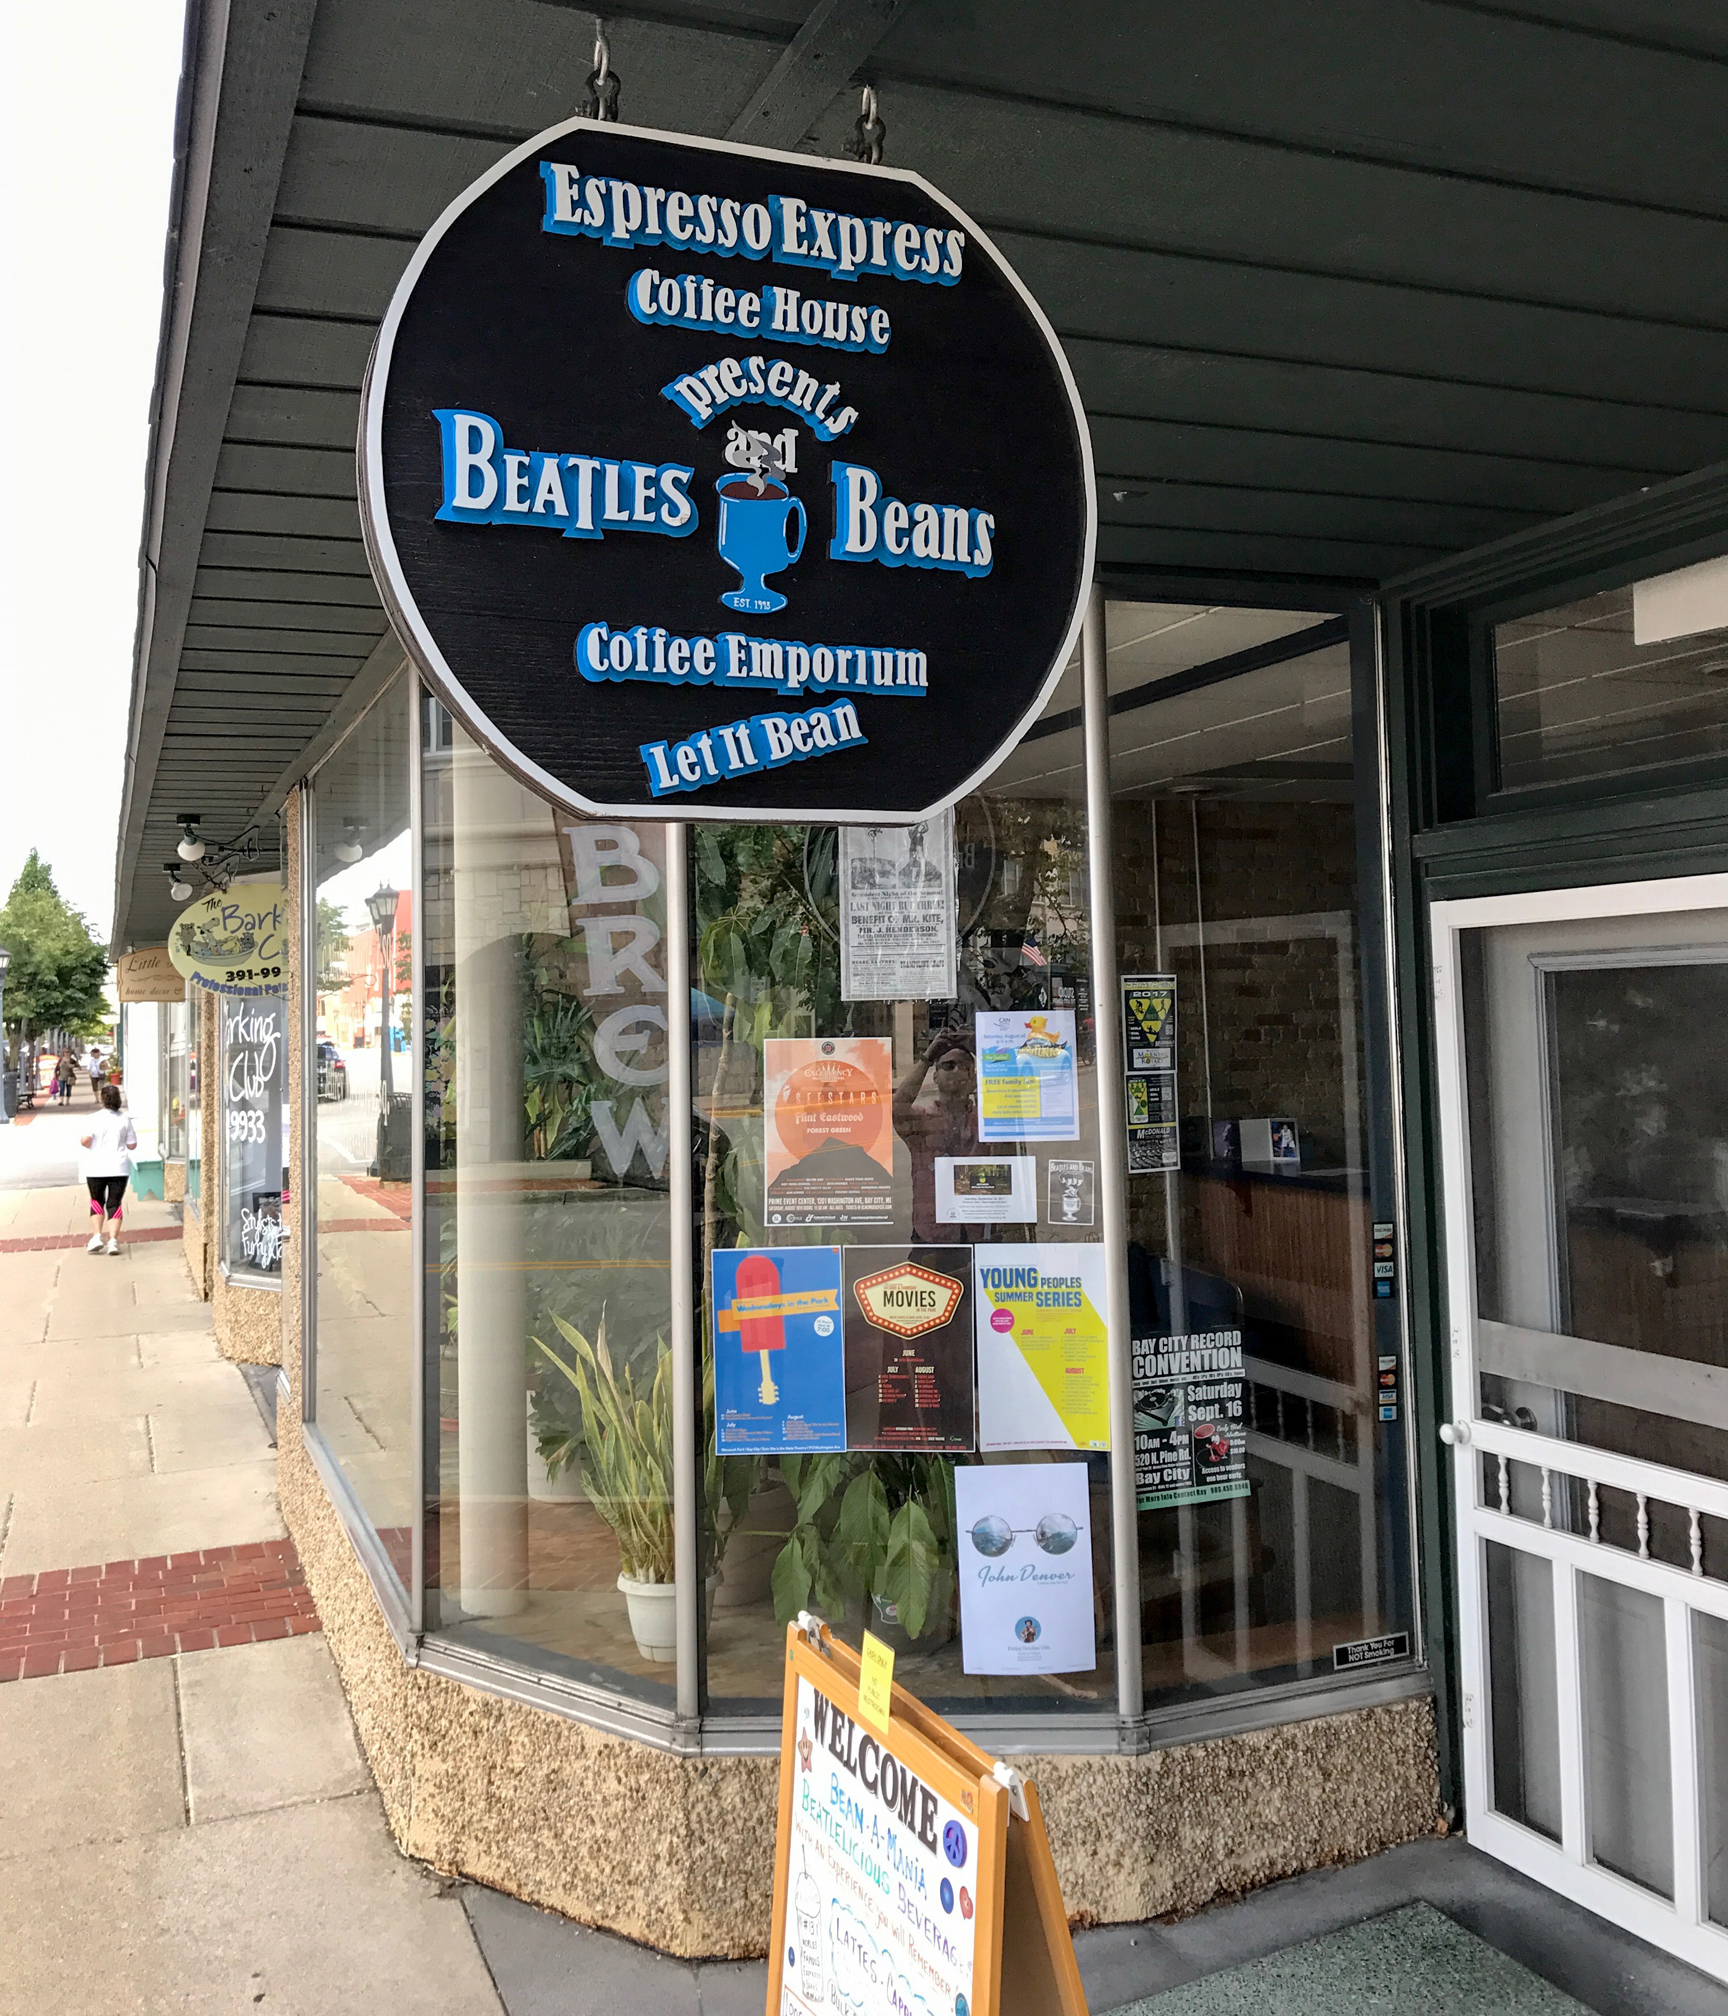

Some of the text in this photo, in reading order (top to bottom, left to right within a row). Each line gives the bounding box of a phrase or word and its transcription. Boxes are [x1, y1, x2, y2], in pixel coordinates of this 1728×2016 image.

[543, 162, 967, 285] Espresso Express
[629, 268, 892, 353] Coffee House
[664, 356, 859, 440] presents
[433, 410, 697, 538] BEATLES
[831, 460, 995, 577] Beans
[577, 622, 928, 696] Coffee Emporium
[641, 699, 868, 797] Let It Bean
[201, 897, 223, 914] The
[851, 914, 886, 925] BENEFIT
[125, 953, 162, 972] Little
[125, 986, 147, 996] home
[150, 986, 171, 996] decor
[189, 971, 263, 997] Professional
[1002, 1078, 1022, 1087] family
[820, 1112, 864, 1122] Eastwood
[980, 1267, 1082, 1289] YOUNG PEOPLES
[737, 1302, 785, 1313] Wednesdays
[883, 1290, 936, 1308] MOVIES
[994, 1291, 1082, 1308] SUMMER SERIES
[1132, 1330, 1242, 1355] BAY CITY RECORD
[915, 1366, 934, 1374] AUGUST
[1132, 1347, 1242, 1378] CONVENTION
[1187, 1382, 1242, 1402] Saturday
[1188, 1400, 1243, 1422] Sept. 16
[1135, 1434, 1160, 1451] 10AM
[1169, 1431, 1190, 1446] 4PM
[1135, 1453, 1151, 1467] 520
[1151, 1452, 1159, 1465] N.
[1160, 1450, 1178, 1463] Pine
[1178, 1447, 1191, 1461] Rd.
[1136, 1468, 1191, 1485] Bay City
[978, 1564, 1076, 1588] John Denver
[1348, 1644, 1369, 1654] Thank
[1370, 1641, 1383, 1649] You
[1349, 1648, 1395, 1662] NOT Smoking
[814, 1687, 939, 1857] WELCOME
